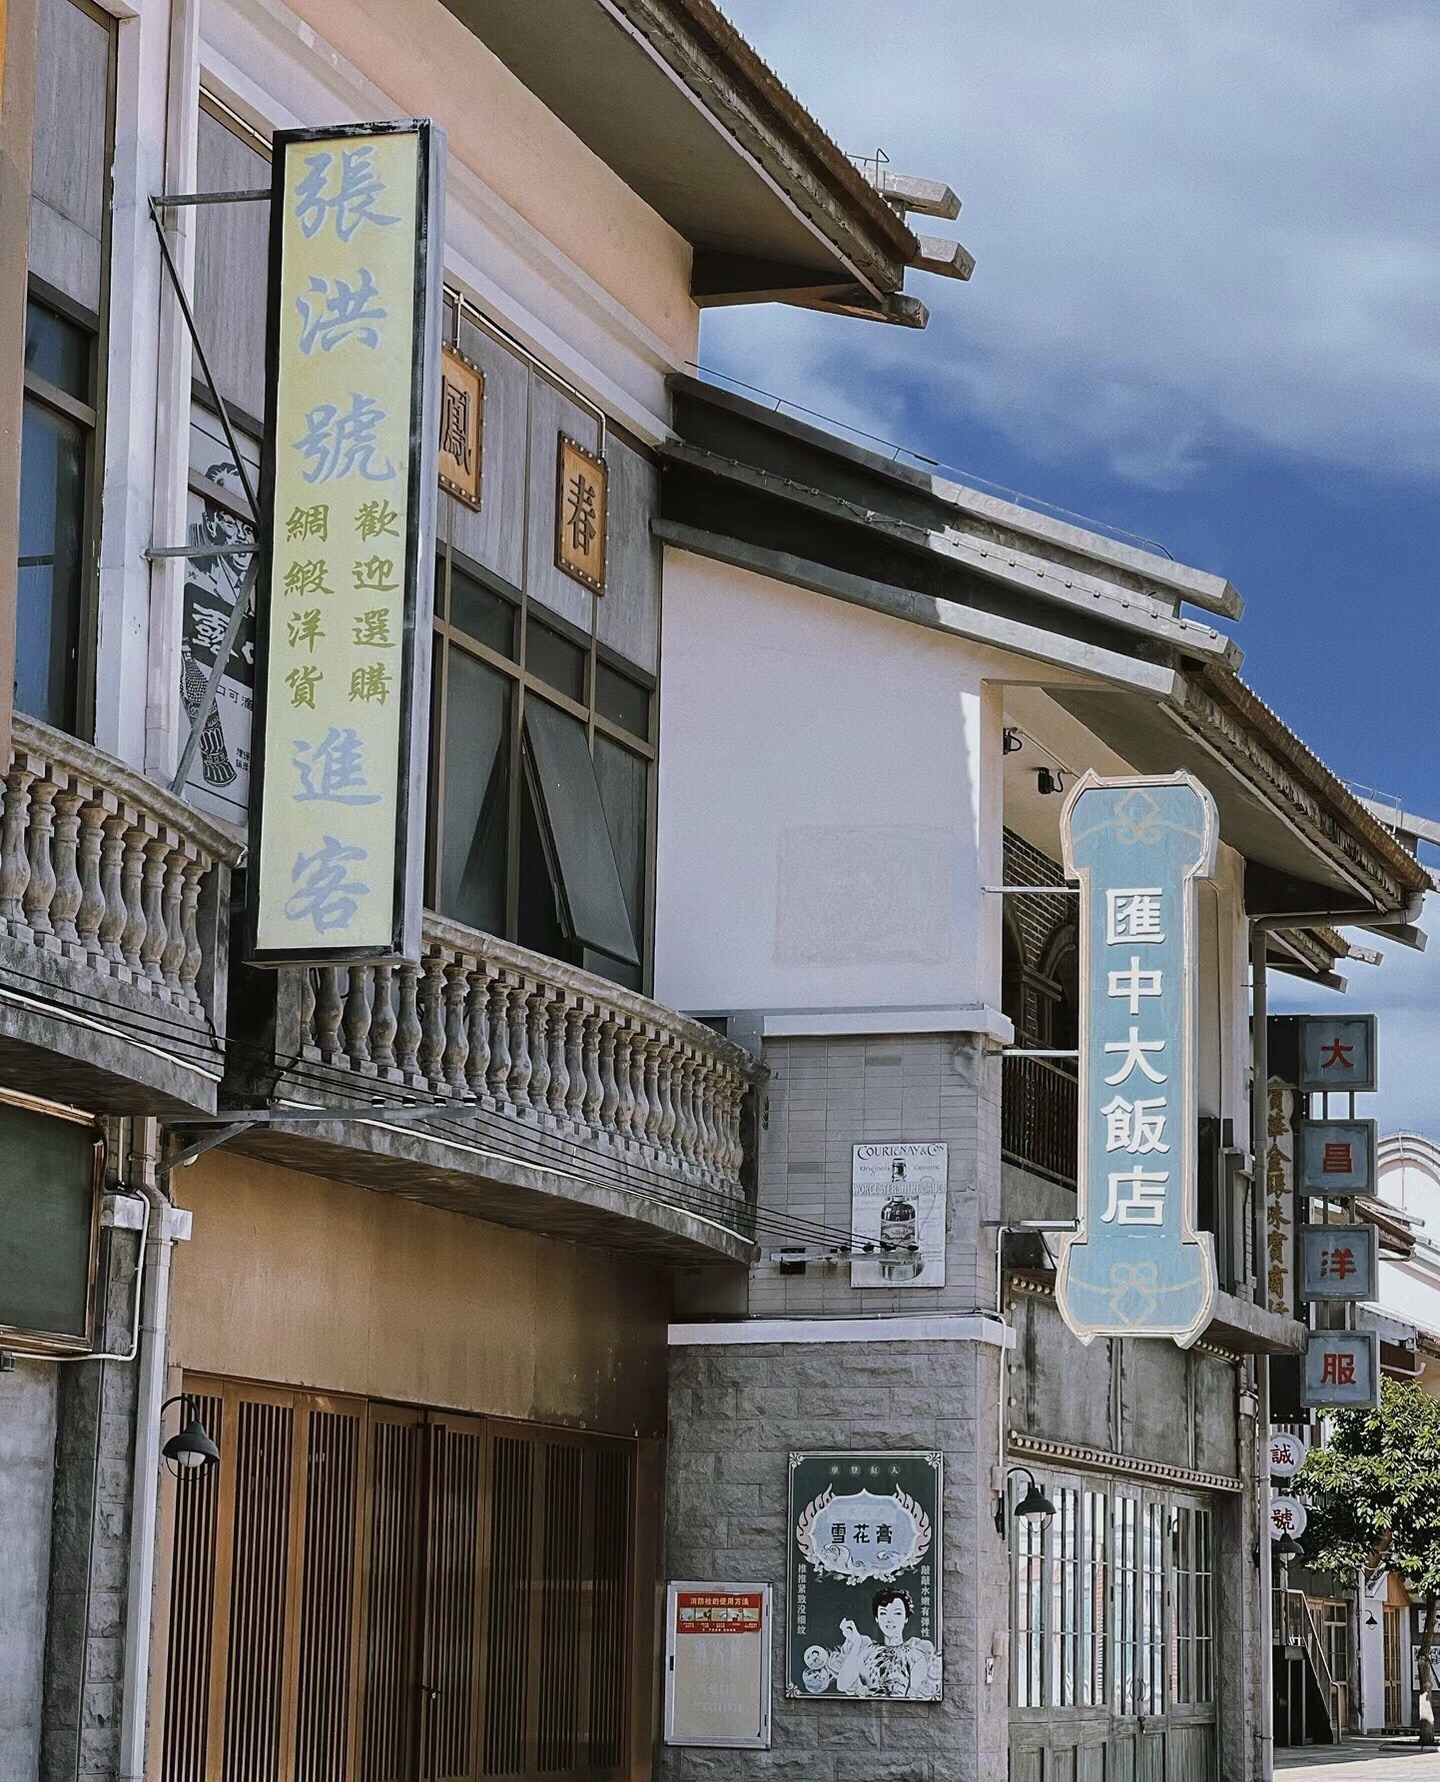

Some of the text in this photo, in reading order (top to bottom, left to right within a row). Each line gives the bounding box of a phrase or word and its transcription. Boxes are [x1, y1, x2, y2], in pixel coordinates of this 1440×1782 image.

[291, 145, 403, 485] 張洪號
[282, 503, 335, 710] 綢緞洋貨
[347, 499, 401, 706] 歡迎選購
[1100, 886, 1170, 1226] 匯中大飯店
[831, 1523, 893, 1545] 雪花膏
